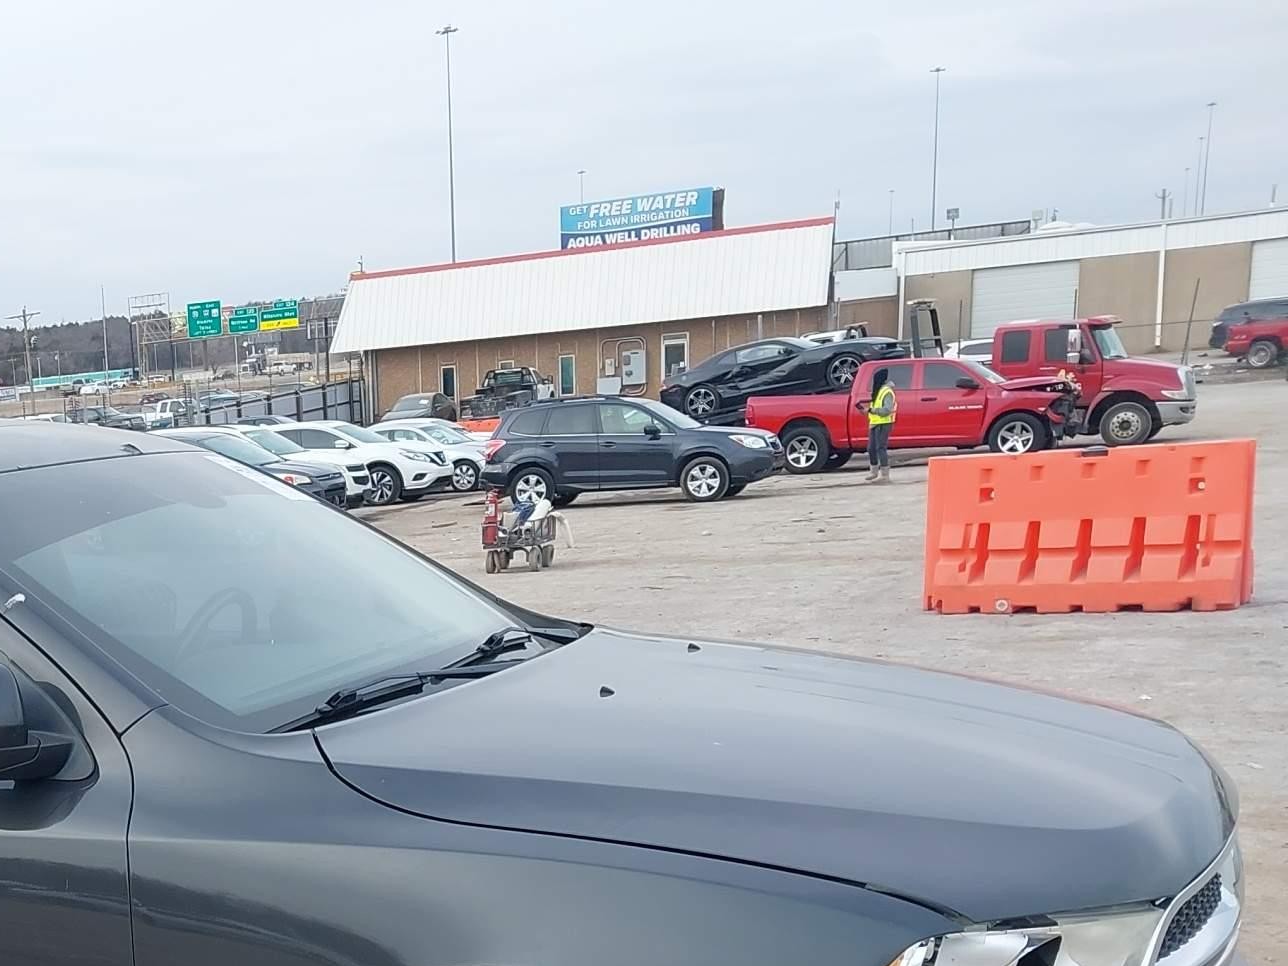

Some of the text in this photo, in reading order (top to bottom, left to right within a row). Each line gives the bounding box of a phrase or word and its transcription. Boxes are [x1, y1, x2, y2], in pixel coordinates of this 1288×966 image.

[569, 191, 698, 218] GET FREE WATER
[577, 208, 689, 230] FOR LAWN IRRIGATION
[567, 223, 701, 249] AQUA WELL DRILLING
